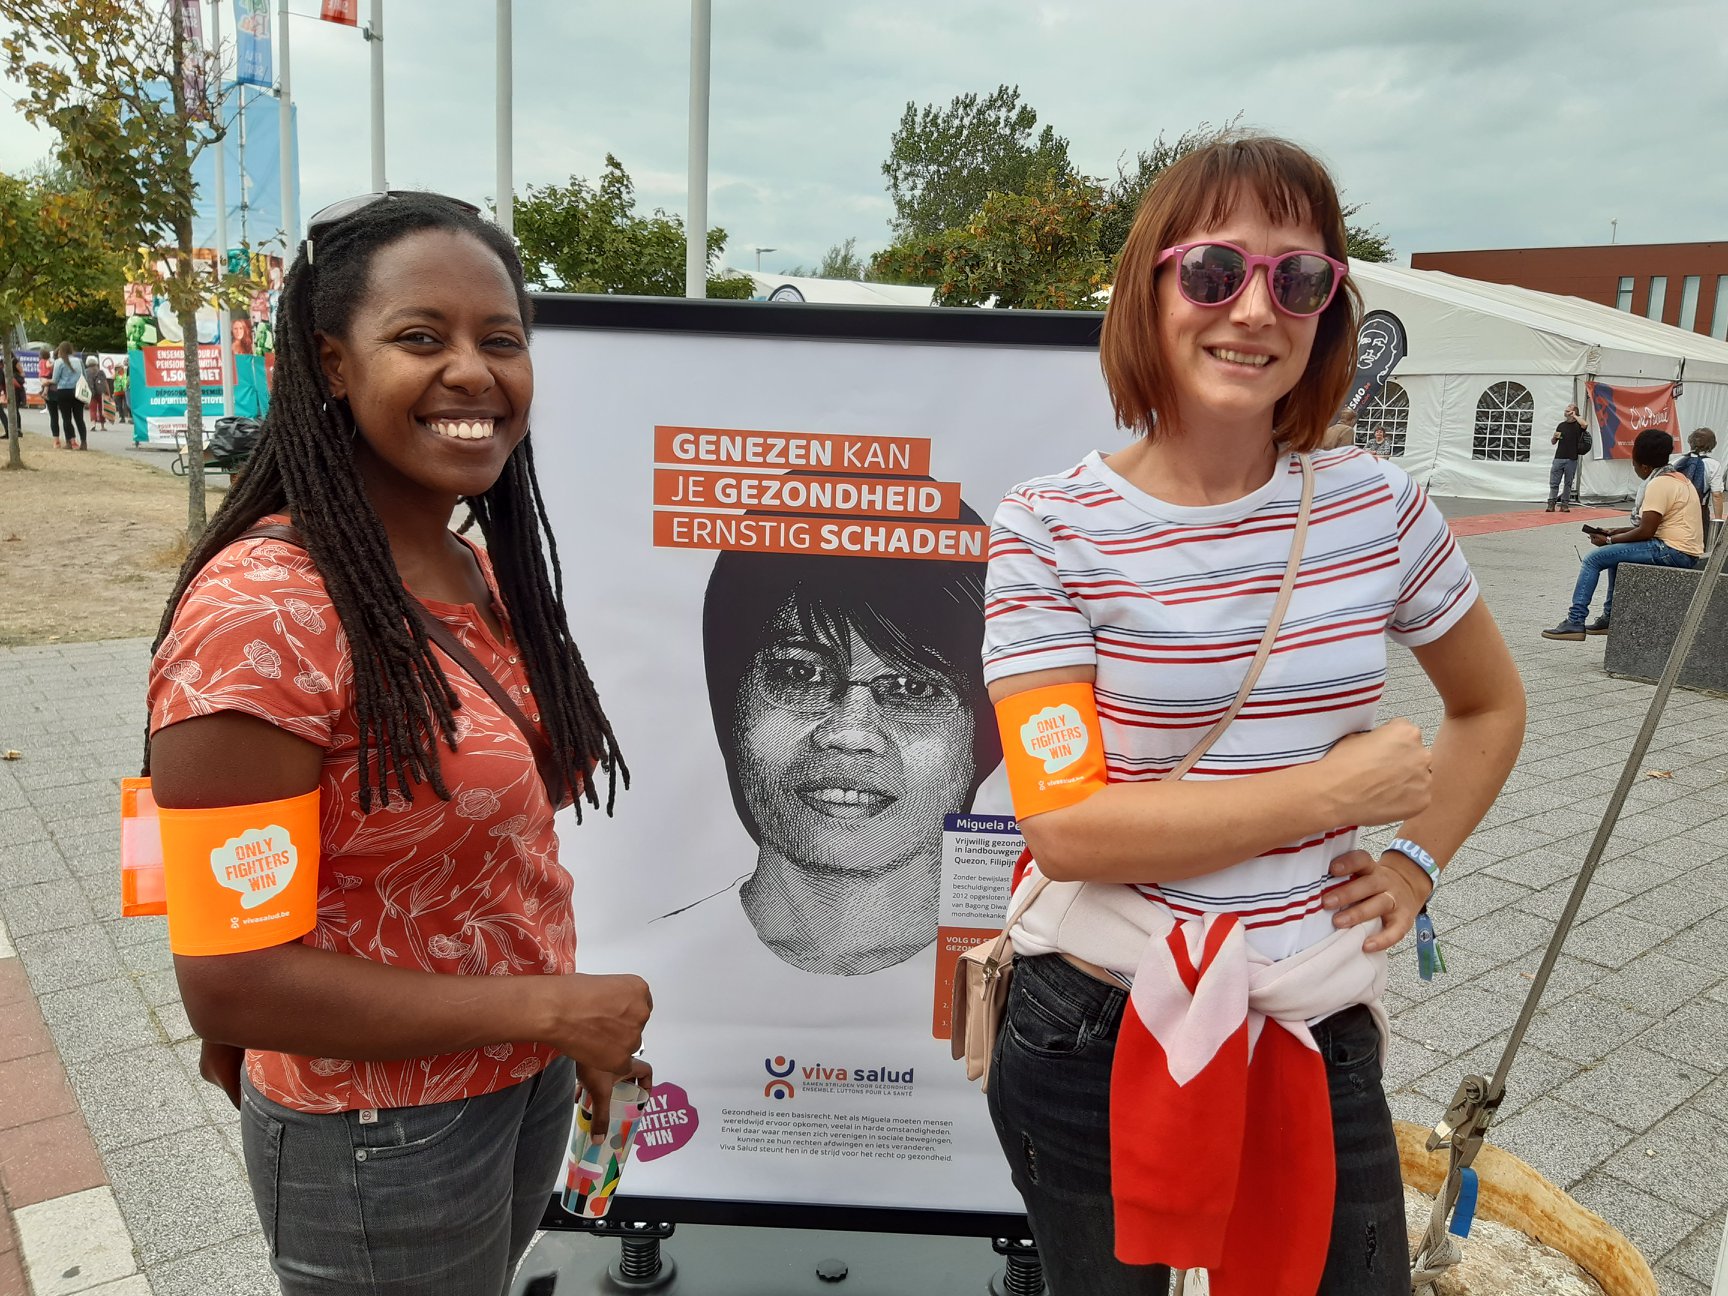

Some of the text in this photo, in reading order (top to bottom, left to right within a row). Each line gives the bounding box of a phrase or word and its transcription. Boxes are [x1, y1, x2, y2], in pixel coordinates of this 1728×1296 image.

[157, 350, 185, 359] ENSEMB
[198, 350, 211, 358] OUR
[672, 432, 910, 470] GENEZEN KAN
[671, 475, 942, 513] JE GEZONDHEID
[673, 517, 982, 556] ERNSTIG SCHADEN
[1037, 714, 1066, 733] ONLY
[1031, 726, 1082, 751] FIGHTERS
[1049, 744, 1072, 760] WIN
[956, 819, 1021, 831] Miguela Pe
[235, 837, 272, 861] ONLY
[955, 838, 1027, 848] Vrijwillig gezondh
[965, 847, 1022, 857] landbouwgem
[225, 850, 290, 880] FIGHTERS
[955, 857, 1016, 867] Quezon, Filipijn
[248, 872, 277, 892] WIN
[802, 1063, 914, 1084] viva salud
[723, 1118, 764, 1126] wereldwijd
[886, 1127, 951, 1135] omstandigheden.
[792, 1112, 832, 1120] basisrecht.
[862, 1115, 891, 1124] Miguela
[643, 1129, 673, 1146] WIN
[824, 1140, 863, 1148] afdwingen
[830, 1132, 867, 1140] verenigen
[737, 1144, 758, 1152] Salud
[821, 1149, 840, 1157] strijd
